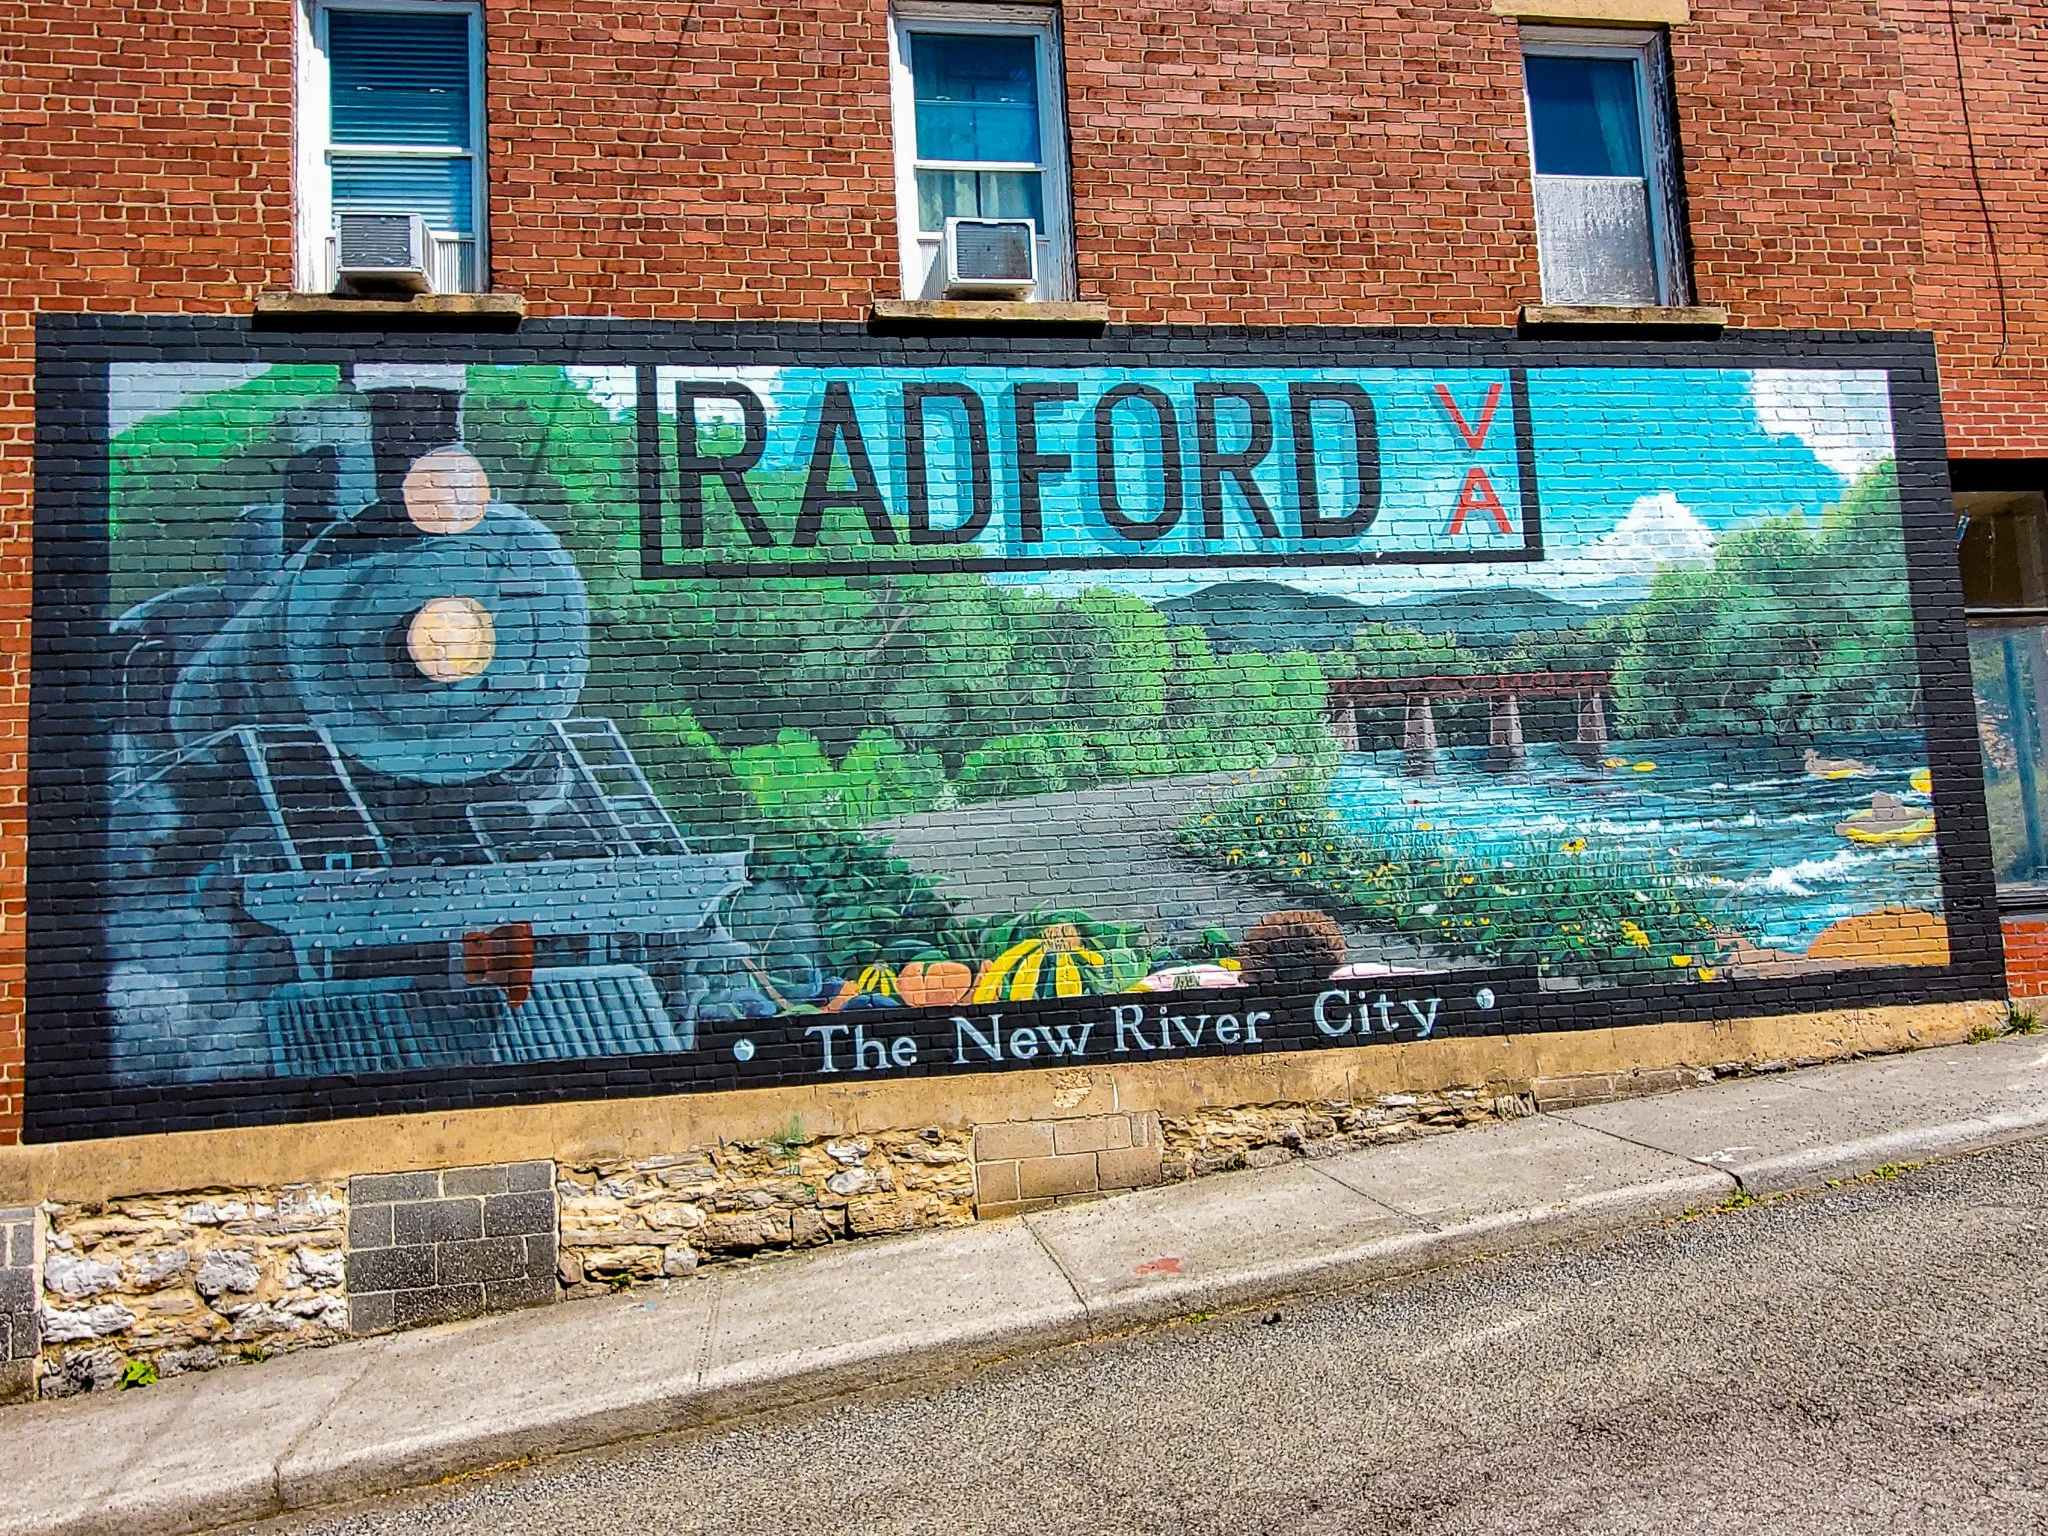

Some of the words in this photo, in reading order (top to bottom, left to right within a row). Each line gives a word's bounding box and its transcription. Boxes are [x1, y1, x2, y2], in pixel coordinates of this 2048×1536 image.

[675, 381, 1379, 548] RADFORD
[804, 1024, 918, 1073] The
[950, 1014, 1093, 1065] New
[1113, 1005, 1271, 1052] River
[1313, 989, 1442, 1038] City
